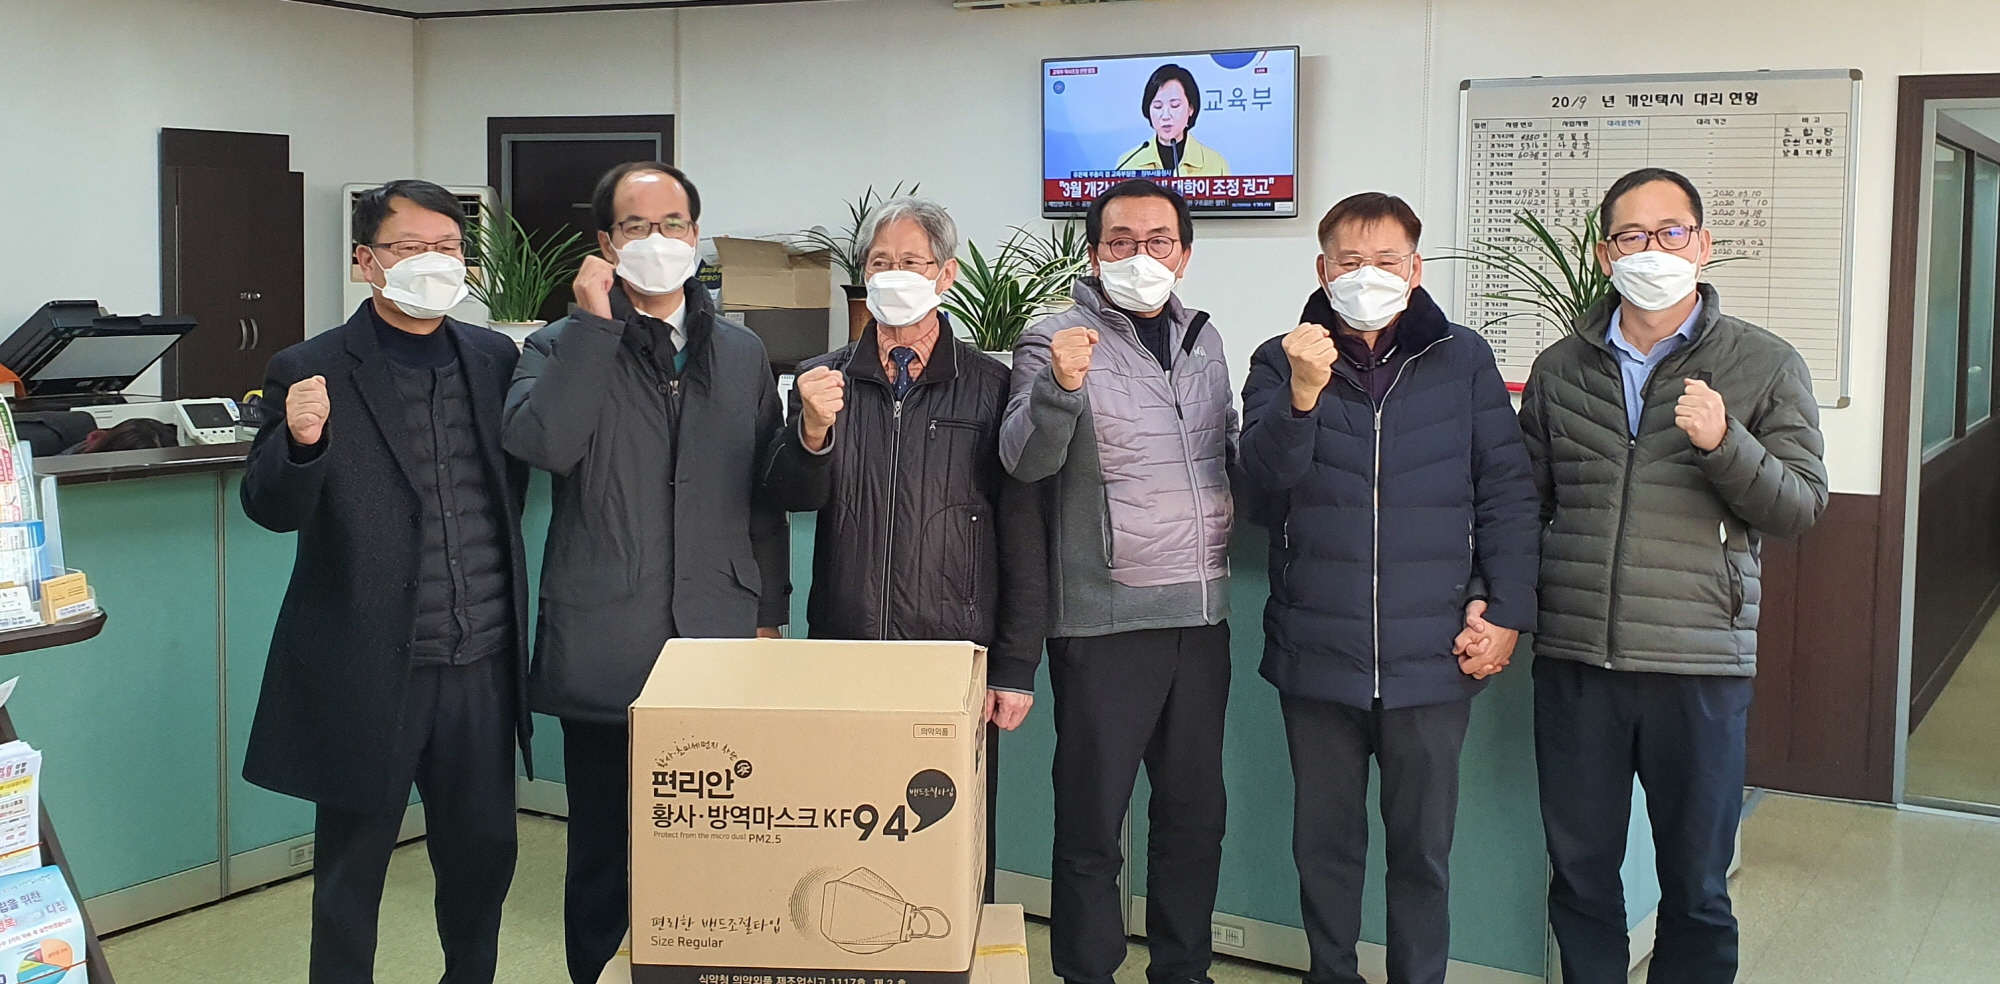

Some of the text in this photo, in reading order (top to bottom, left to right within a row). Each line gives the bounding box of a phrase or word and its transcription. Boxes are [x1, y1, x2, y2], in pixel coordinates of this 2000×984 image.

[1204, 87, 1272, 112] 교육부
[1602, 94, 1615, 108] 년
[1625, 93, 1684, 107] 개인택시
[1694, 92, 1723, 106] 대리
[1212, 179, 1240, 196] 조정
[921, 727, 948, 737] 의약외품
[652, 768, 735, 799] 편리안
[909, 786, 954, 799] 밴드조절타입
[652, 803, 819, 831] 황사·방역마스크
[653, 831, 678, 839] Protect
[679, 831, 697, 839] from
[711, 832, 730, 840] micro
[731, 832, 747, 840] dust
[748, 834, 782, 844] PM2.5
[20, 891, 42, 906] 위한
[651, 914, 781, 935] 편리한 밴드조절타입
[651, 936, 724, 950] Size Regular
[699, 974, 729, 984] 식약청
